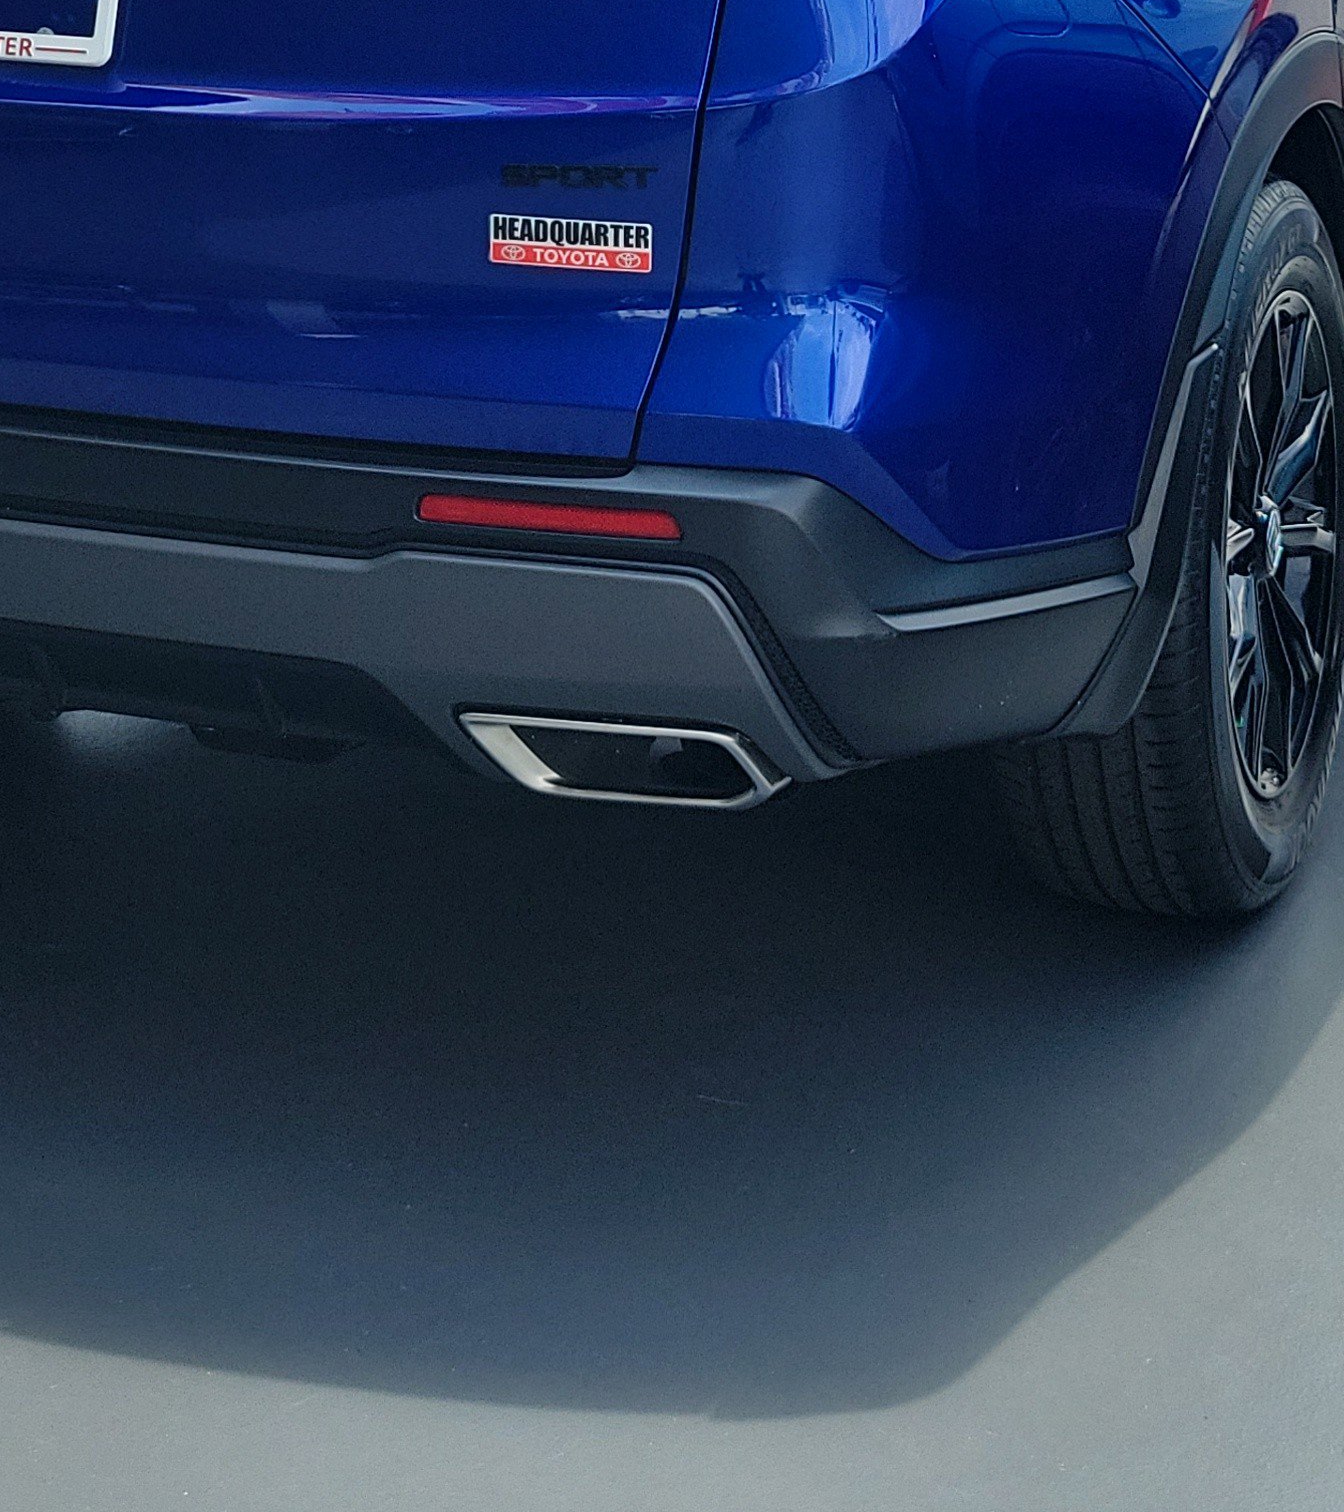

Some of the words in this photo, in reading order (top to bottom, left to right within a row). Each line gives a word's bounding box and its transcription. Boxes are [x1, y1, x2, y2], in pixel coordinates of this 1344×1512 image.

[501, 162, 659, 189] SPORT
[492, 216, 650, 249] HEADQUARTER
[532, 247, 609, 267] TOYOTA
